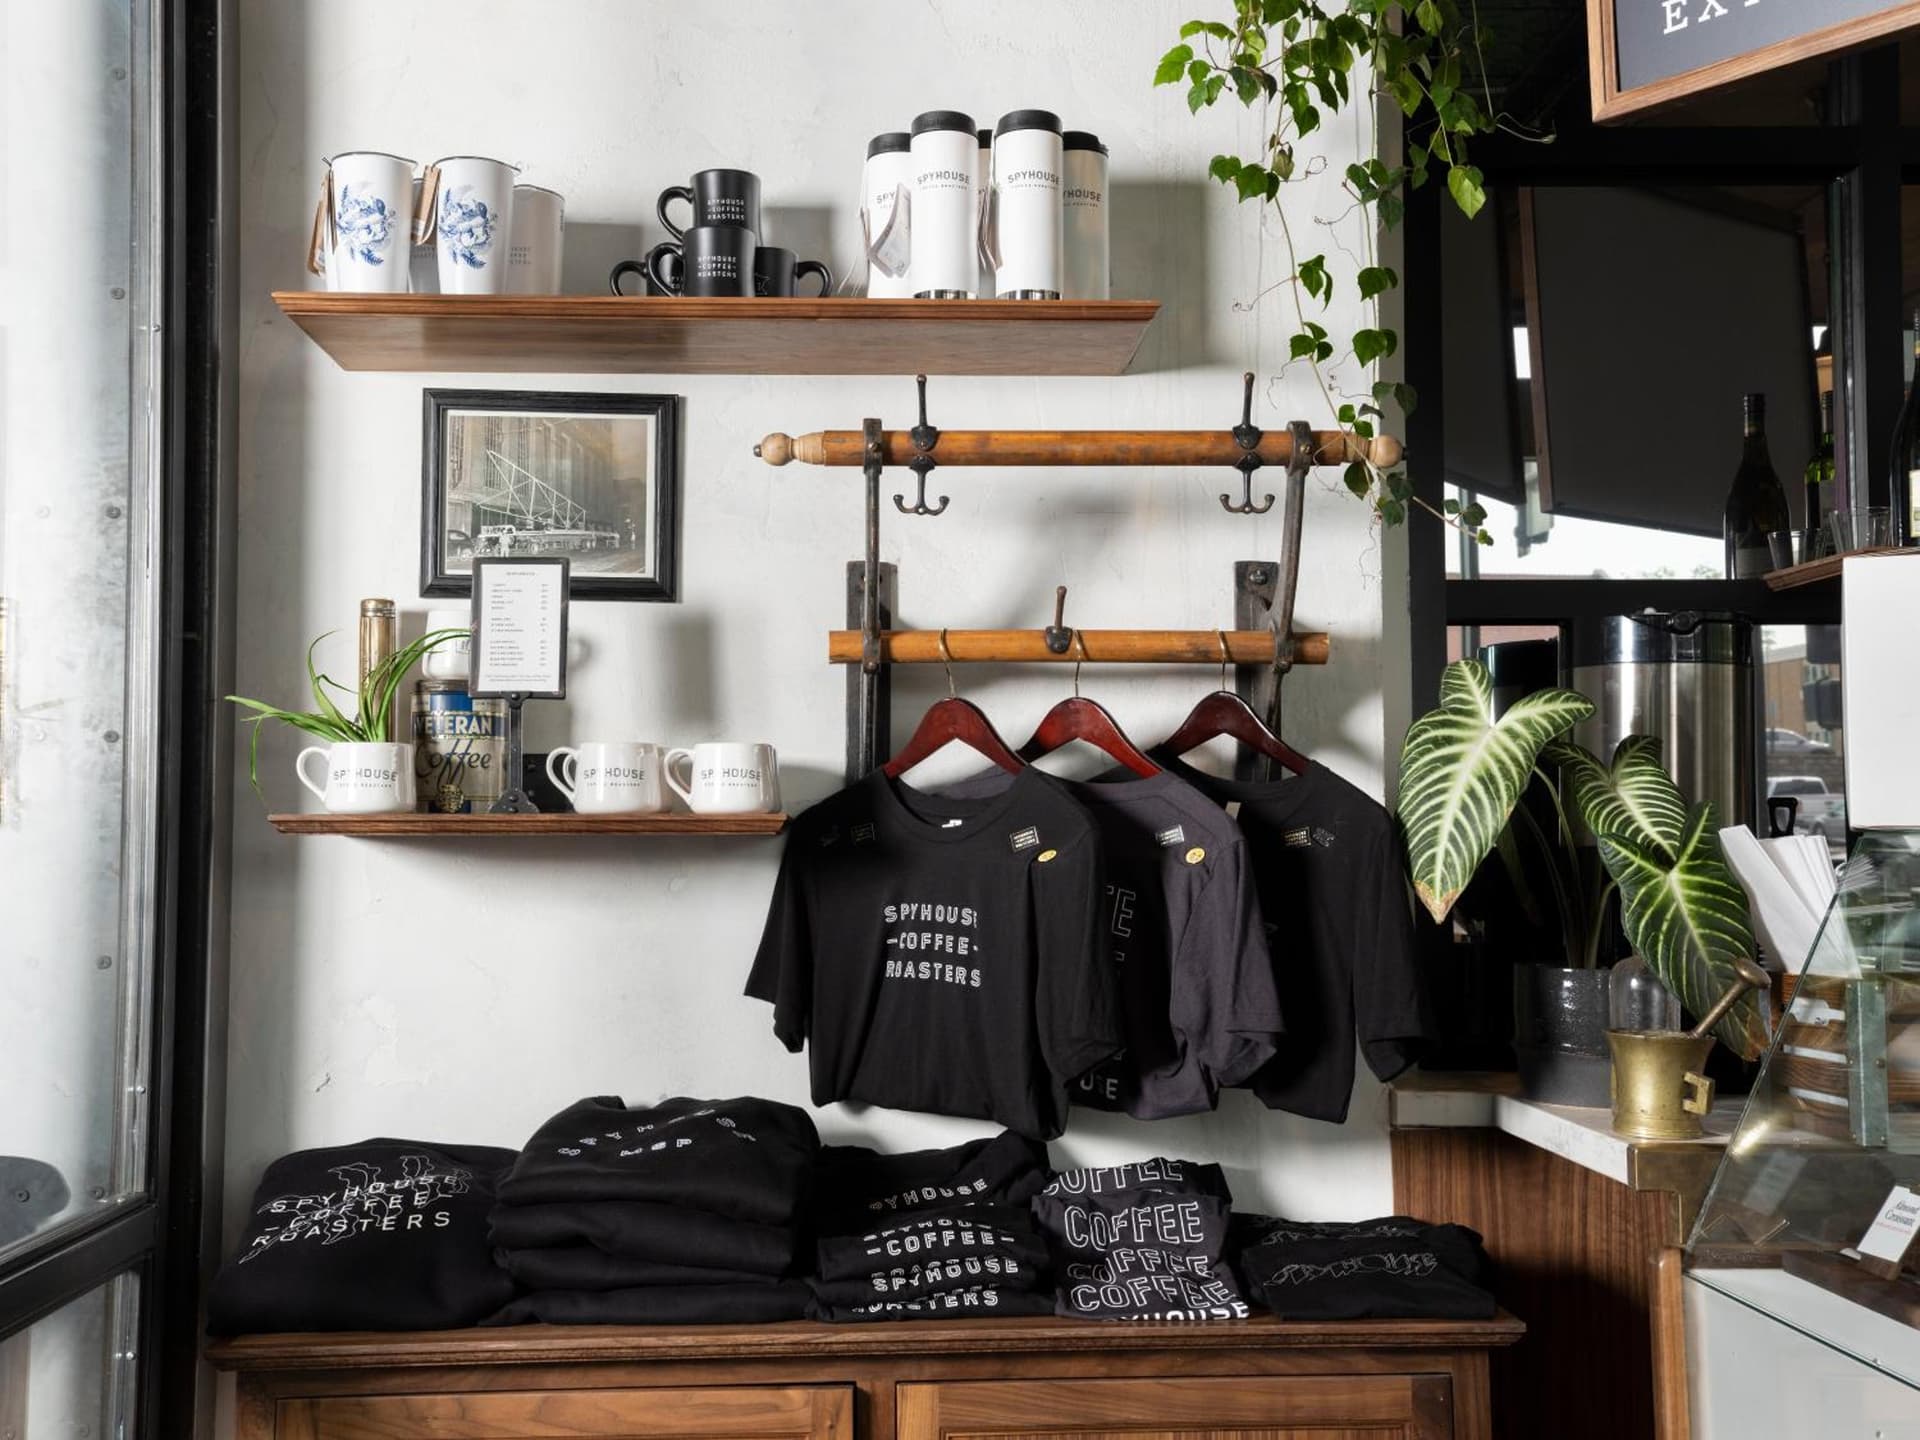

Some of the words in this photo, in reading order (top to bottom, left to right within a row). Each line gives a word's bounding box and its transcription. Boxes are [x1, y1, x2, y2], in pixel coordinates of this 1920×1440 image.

[917, 171, 970, 185] SPYHOUSE
[1007, 170, 1061, 186] SPYHOUSE
[1063, 188, 1102, 202] YHOUSE
[416, 716, 492, 735] VETERAN
[333, 768, 398, 782] SPHOUSE
[583, 767, 645, 781] SPHOUSE
[701, 767, 761, 781] SPHOUSE
[886, 961, 981, 988] ROASTERS
[869, 1178, 988, 1210] PYHOUSE
[252, 1211, 450, 1247] ROASTERS
[1064, 1201, 1204, 1251] COFFEE
[872, 1258, 1018, 1292] SPYHOUSE
[1070, 1275, 1236, 1312] COFFEE
